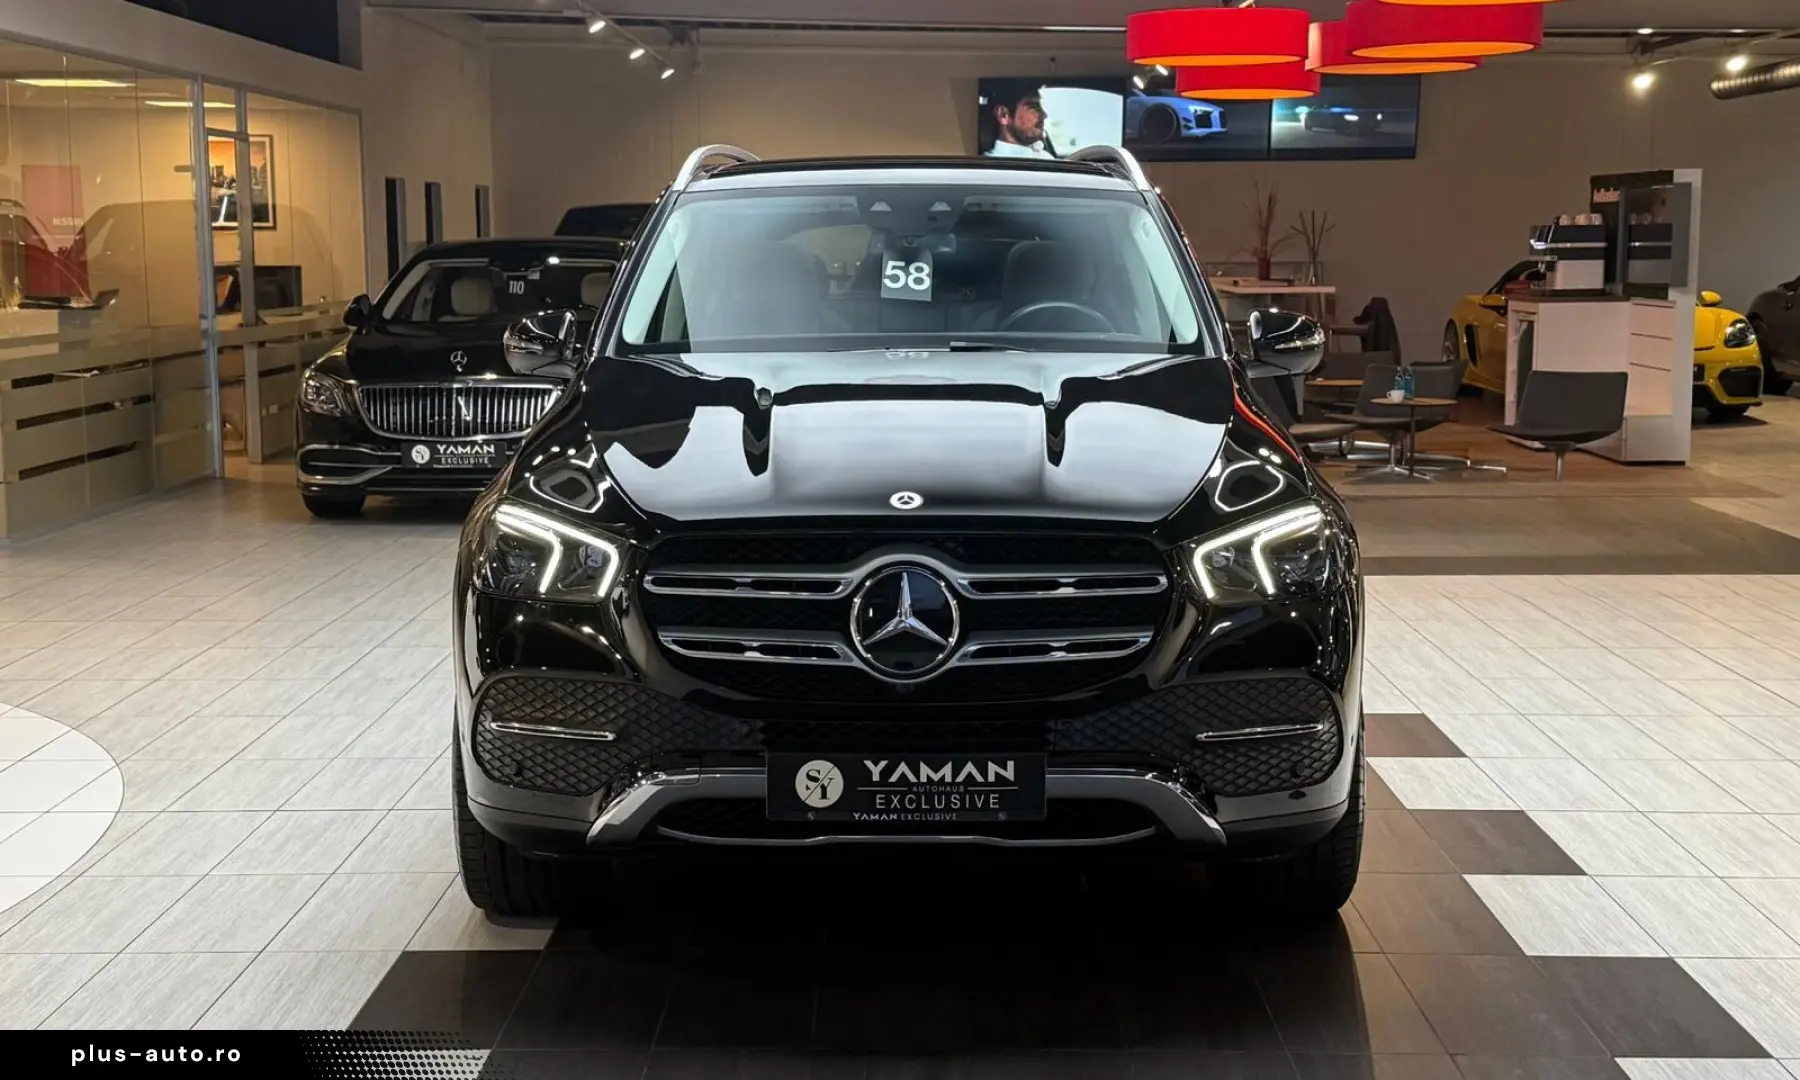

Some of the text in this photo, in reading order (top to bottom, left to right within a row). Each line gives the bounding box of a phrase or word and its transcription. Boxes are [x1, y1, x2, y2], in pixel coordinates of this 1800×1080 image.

[883, 260, 930, 291] 58
[508, 280, 525, 295] 110
[436, 444, 495, 454] YAMAN
[863, 760, 1015, 783] YAMAN
[911, 785, 965, 793] AUTOHAUS
[876, 793, 1000, 809] EXCLUSIVE
[853, 812, 957, 820] YAMAN EXCLUSIVE
